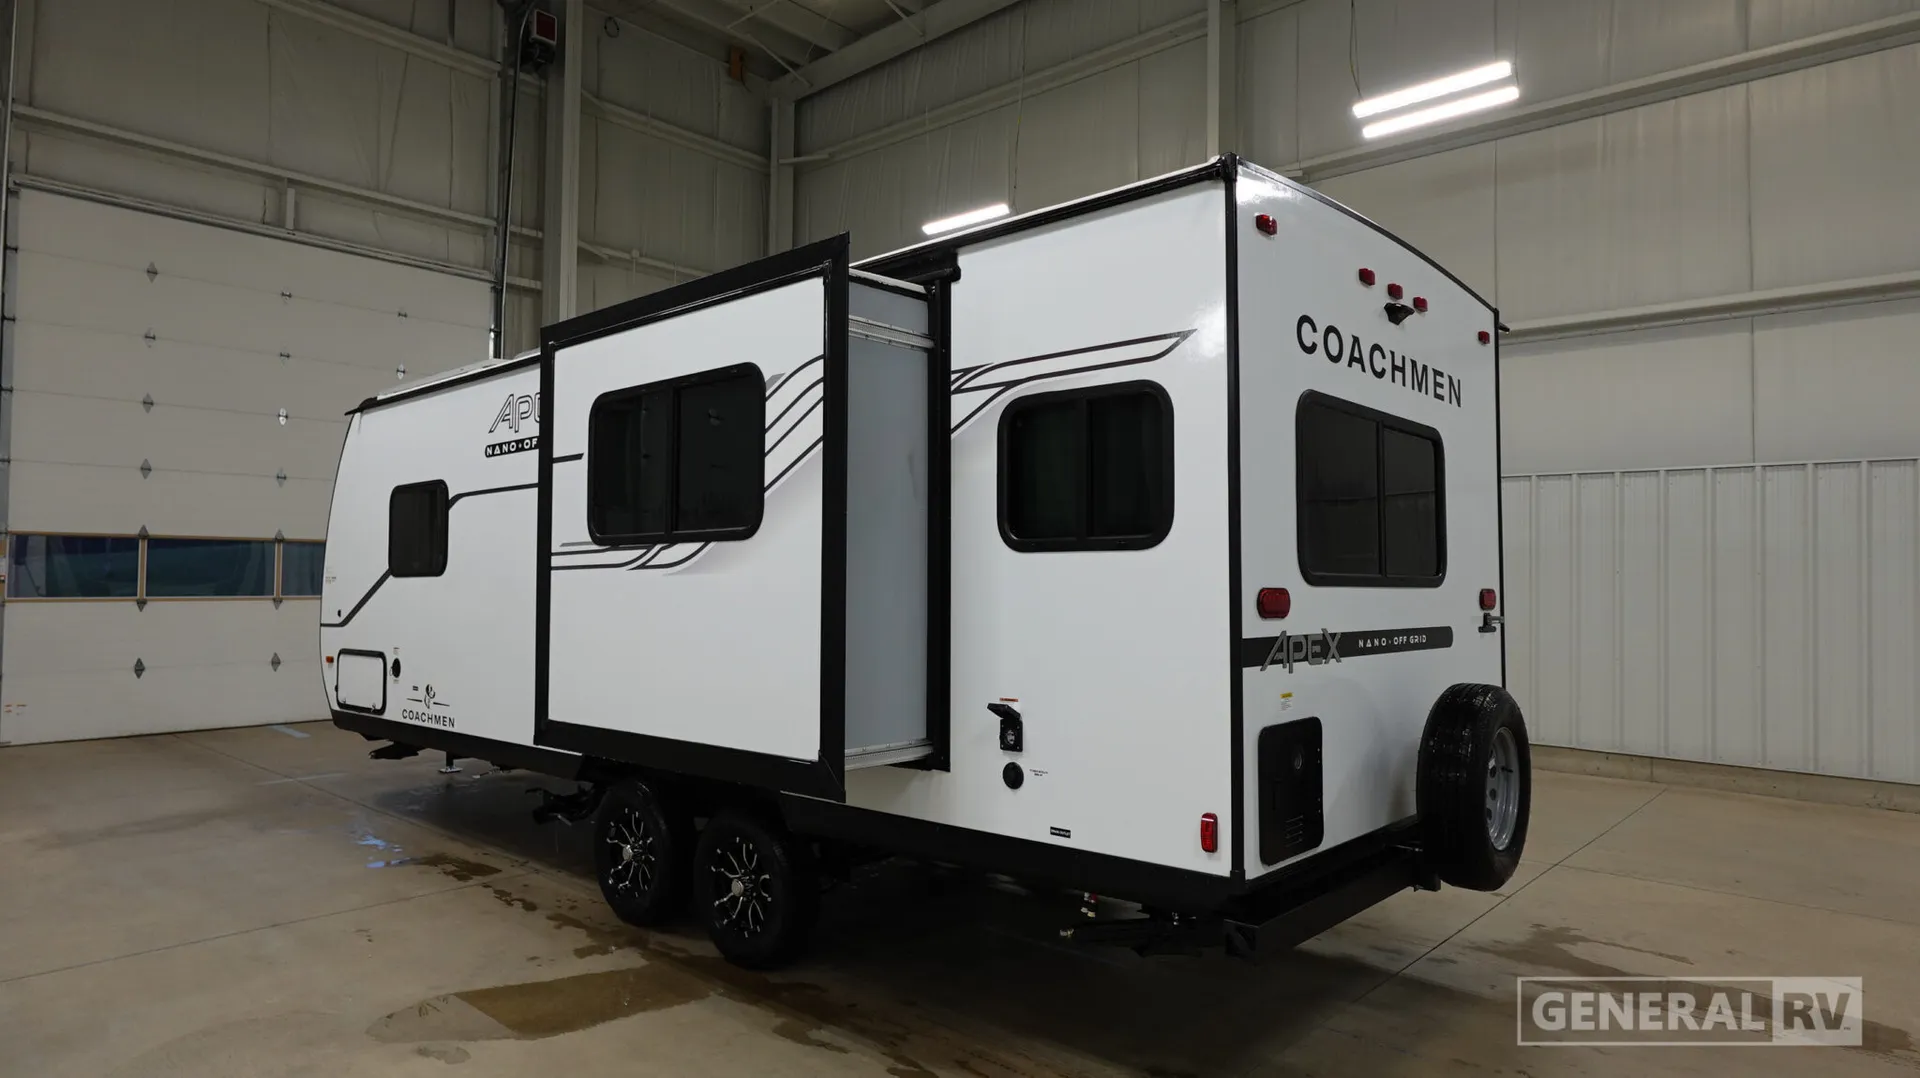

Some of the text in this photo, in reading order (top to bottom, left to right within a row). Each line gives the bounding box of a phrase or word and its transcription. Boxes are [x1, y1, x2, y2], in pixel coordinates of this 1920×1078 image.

[1296, 314, 1462, 408] COACHMEN
[486, 442, 517, 456] NANO
[1260, 627, 1342, 675] APEX
[1358, 634, 1427, 648] NANO OFF GRID
[401, 708, 455, 728] COACHMEN
